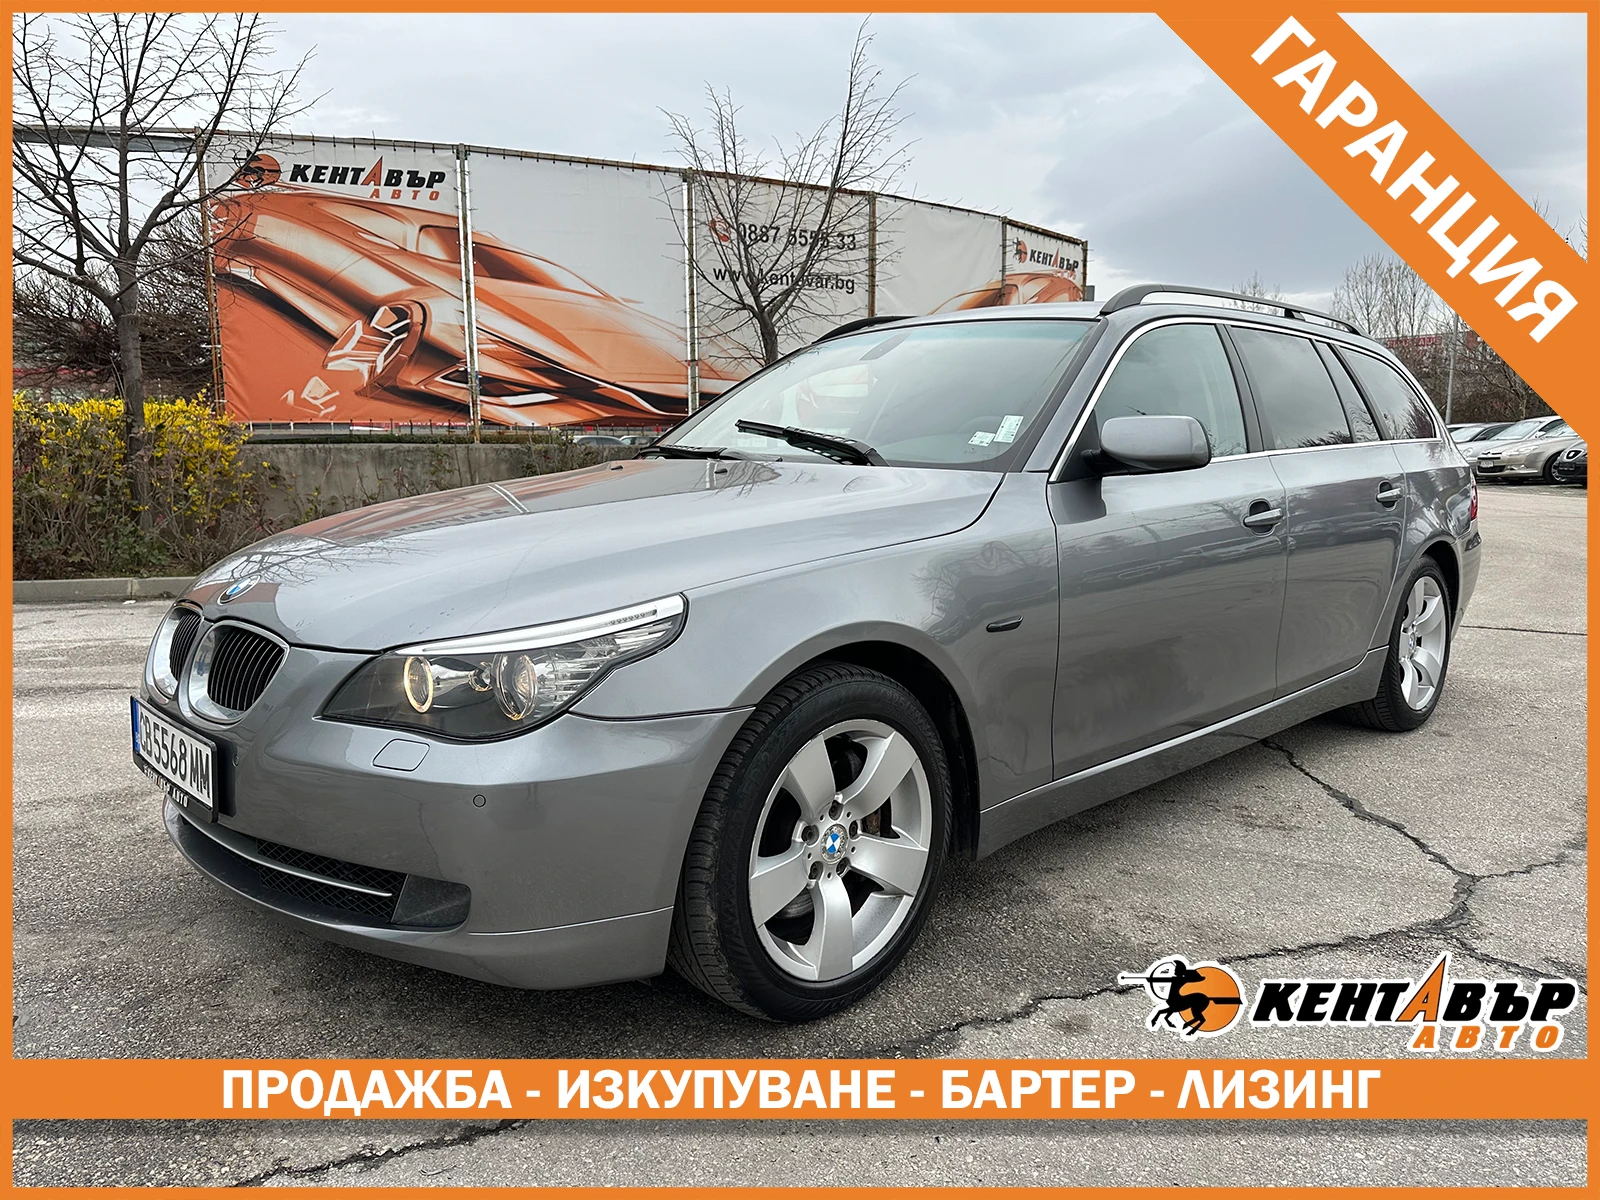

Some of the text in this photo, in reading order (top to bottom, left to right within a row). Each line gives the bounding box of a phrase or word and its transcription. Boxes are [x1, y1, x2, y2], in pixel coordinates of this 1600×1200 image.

[289, 156, 446, 188] КЕНТАВЪР
[370, 188, 440, 200] АВТО
[837, 233, 856, 250] 33
[1029, 247, 1079, 271] КЕНТАВЪР
[713, 268, 855, 294] wwkentvar.bg
